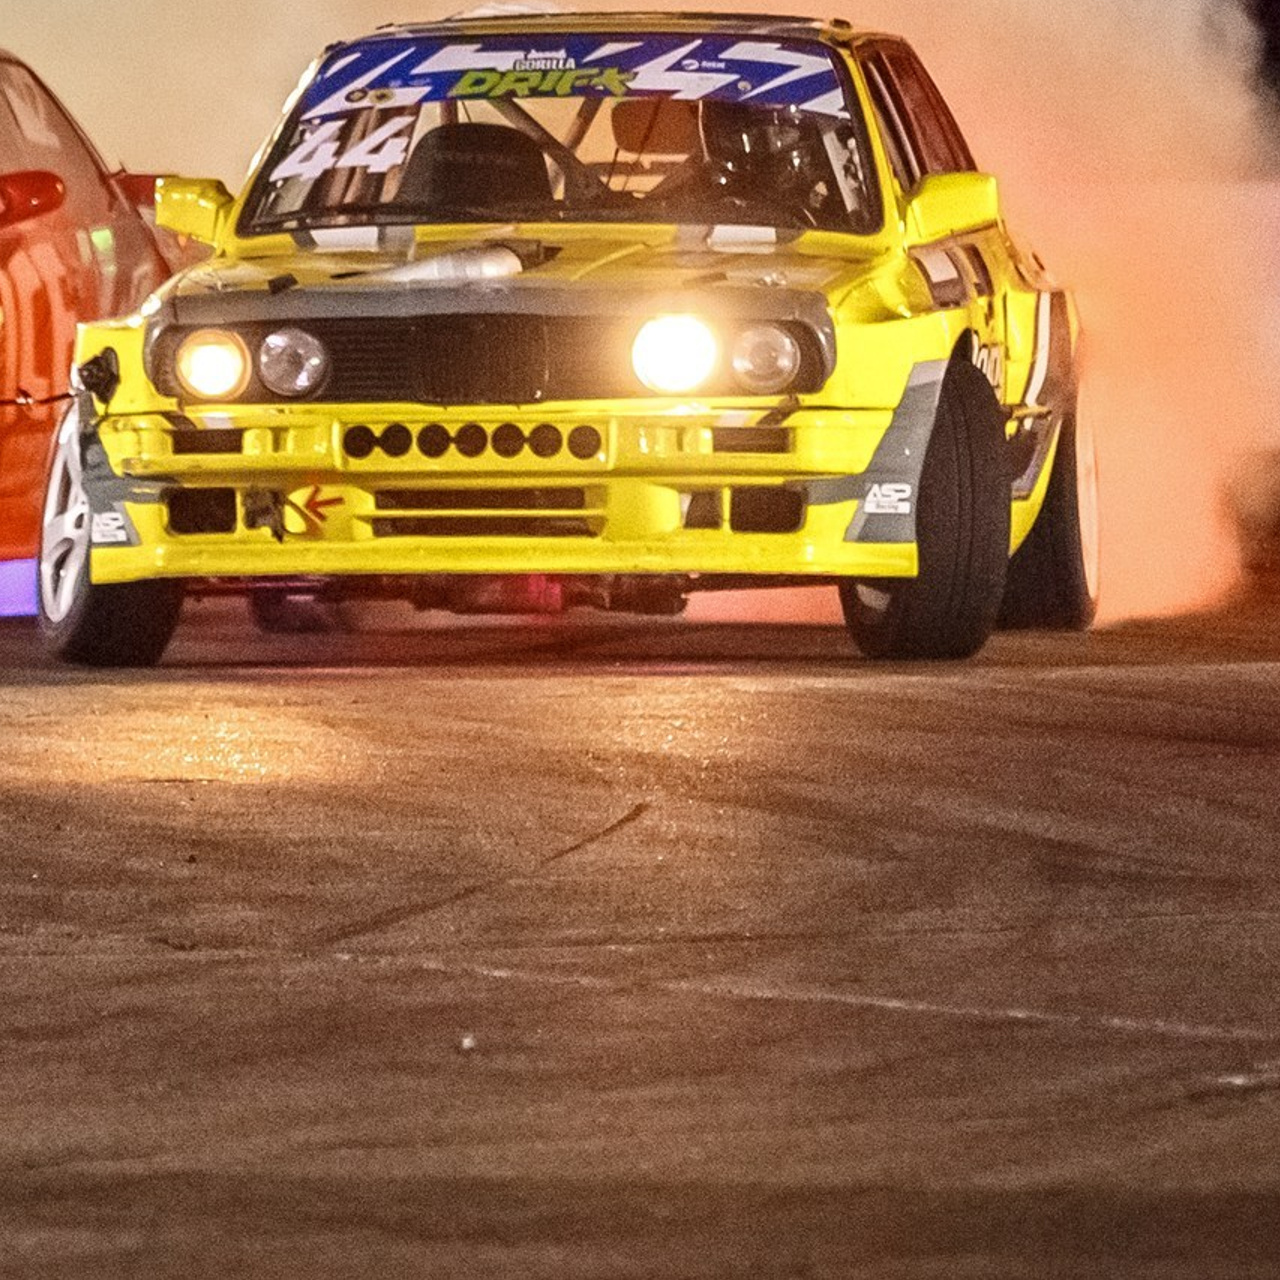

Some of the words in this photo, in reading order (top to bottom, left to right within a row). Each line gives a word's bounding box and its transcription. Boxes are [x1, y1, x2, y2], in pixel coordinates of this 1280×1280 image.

[513, 58, 576, 71] GORILLA
[269, 116, 417, 182] 44
[865, 483, 912, 501] ASP
